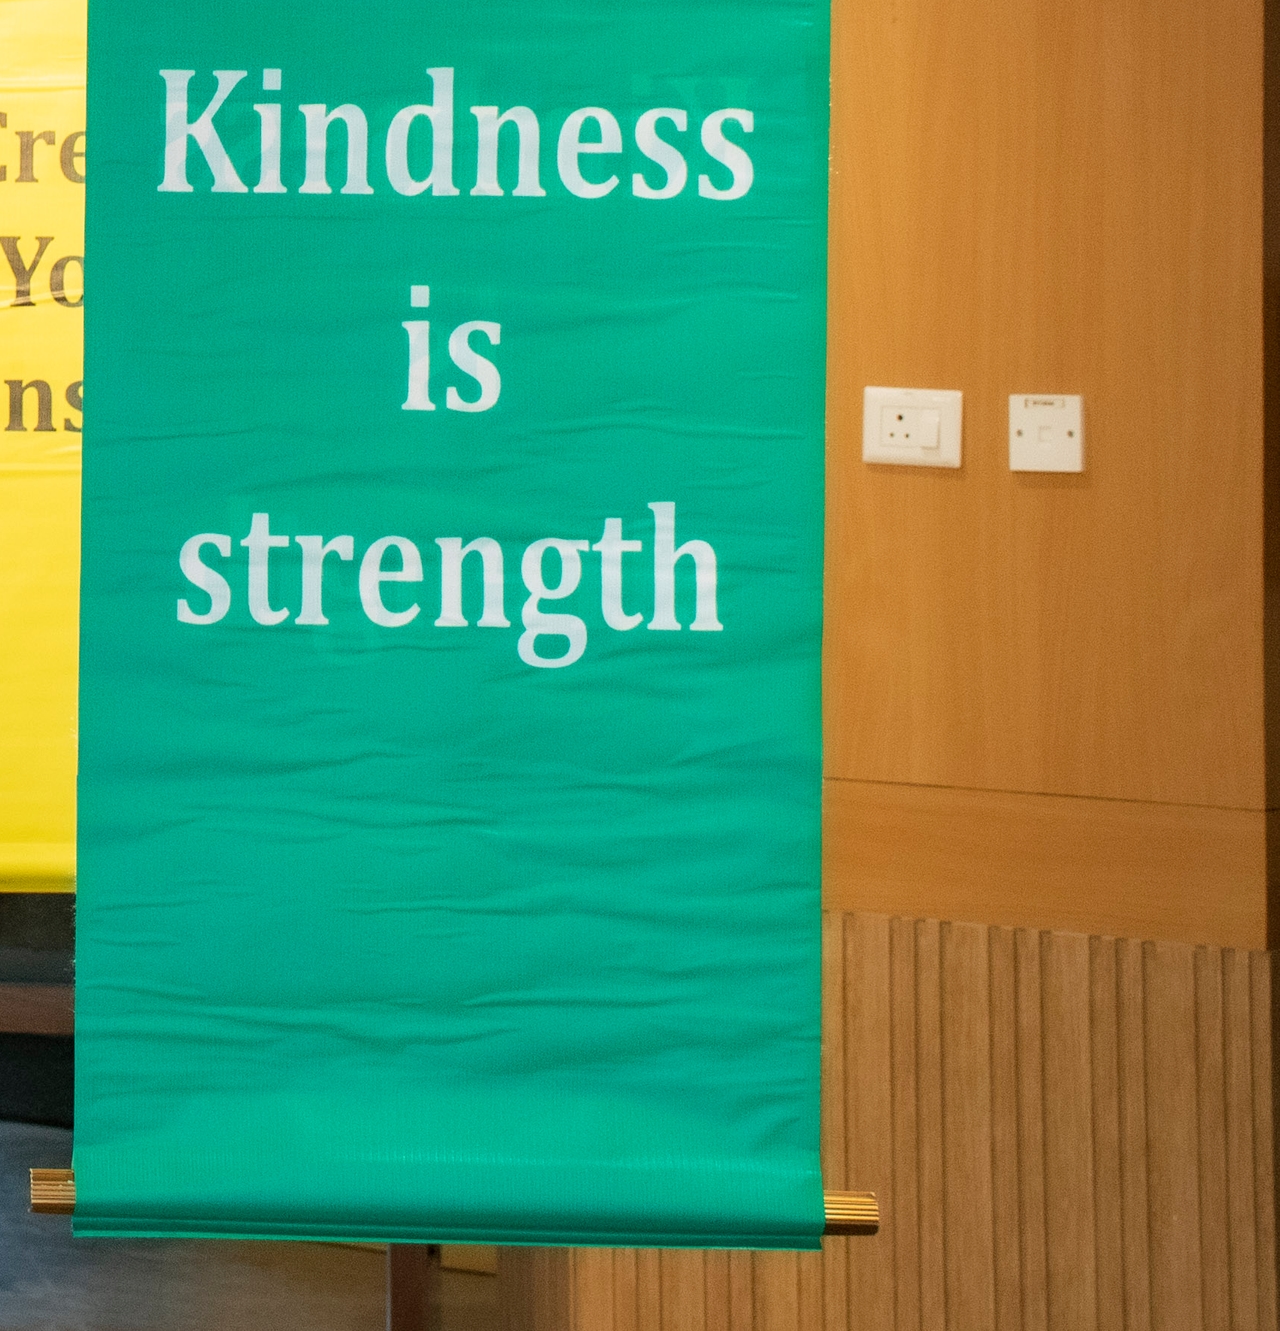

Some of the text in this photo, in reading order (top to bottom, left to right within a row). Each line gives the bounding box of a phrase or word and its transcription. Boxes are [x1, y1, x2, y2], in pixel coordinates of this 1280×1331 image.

[157, 67, 755, 200] Kindness
[401, 285, 502, 413] is
[176, 501, 724, 668] strength
